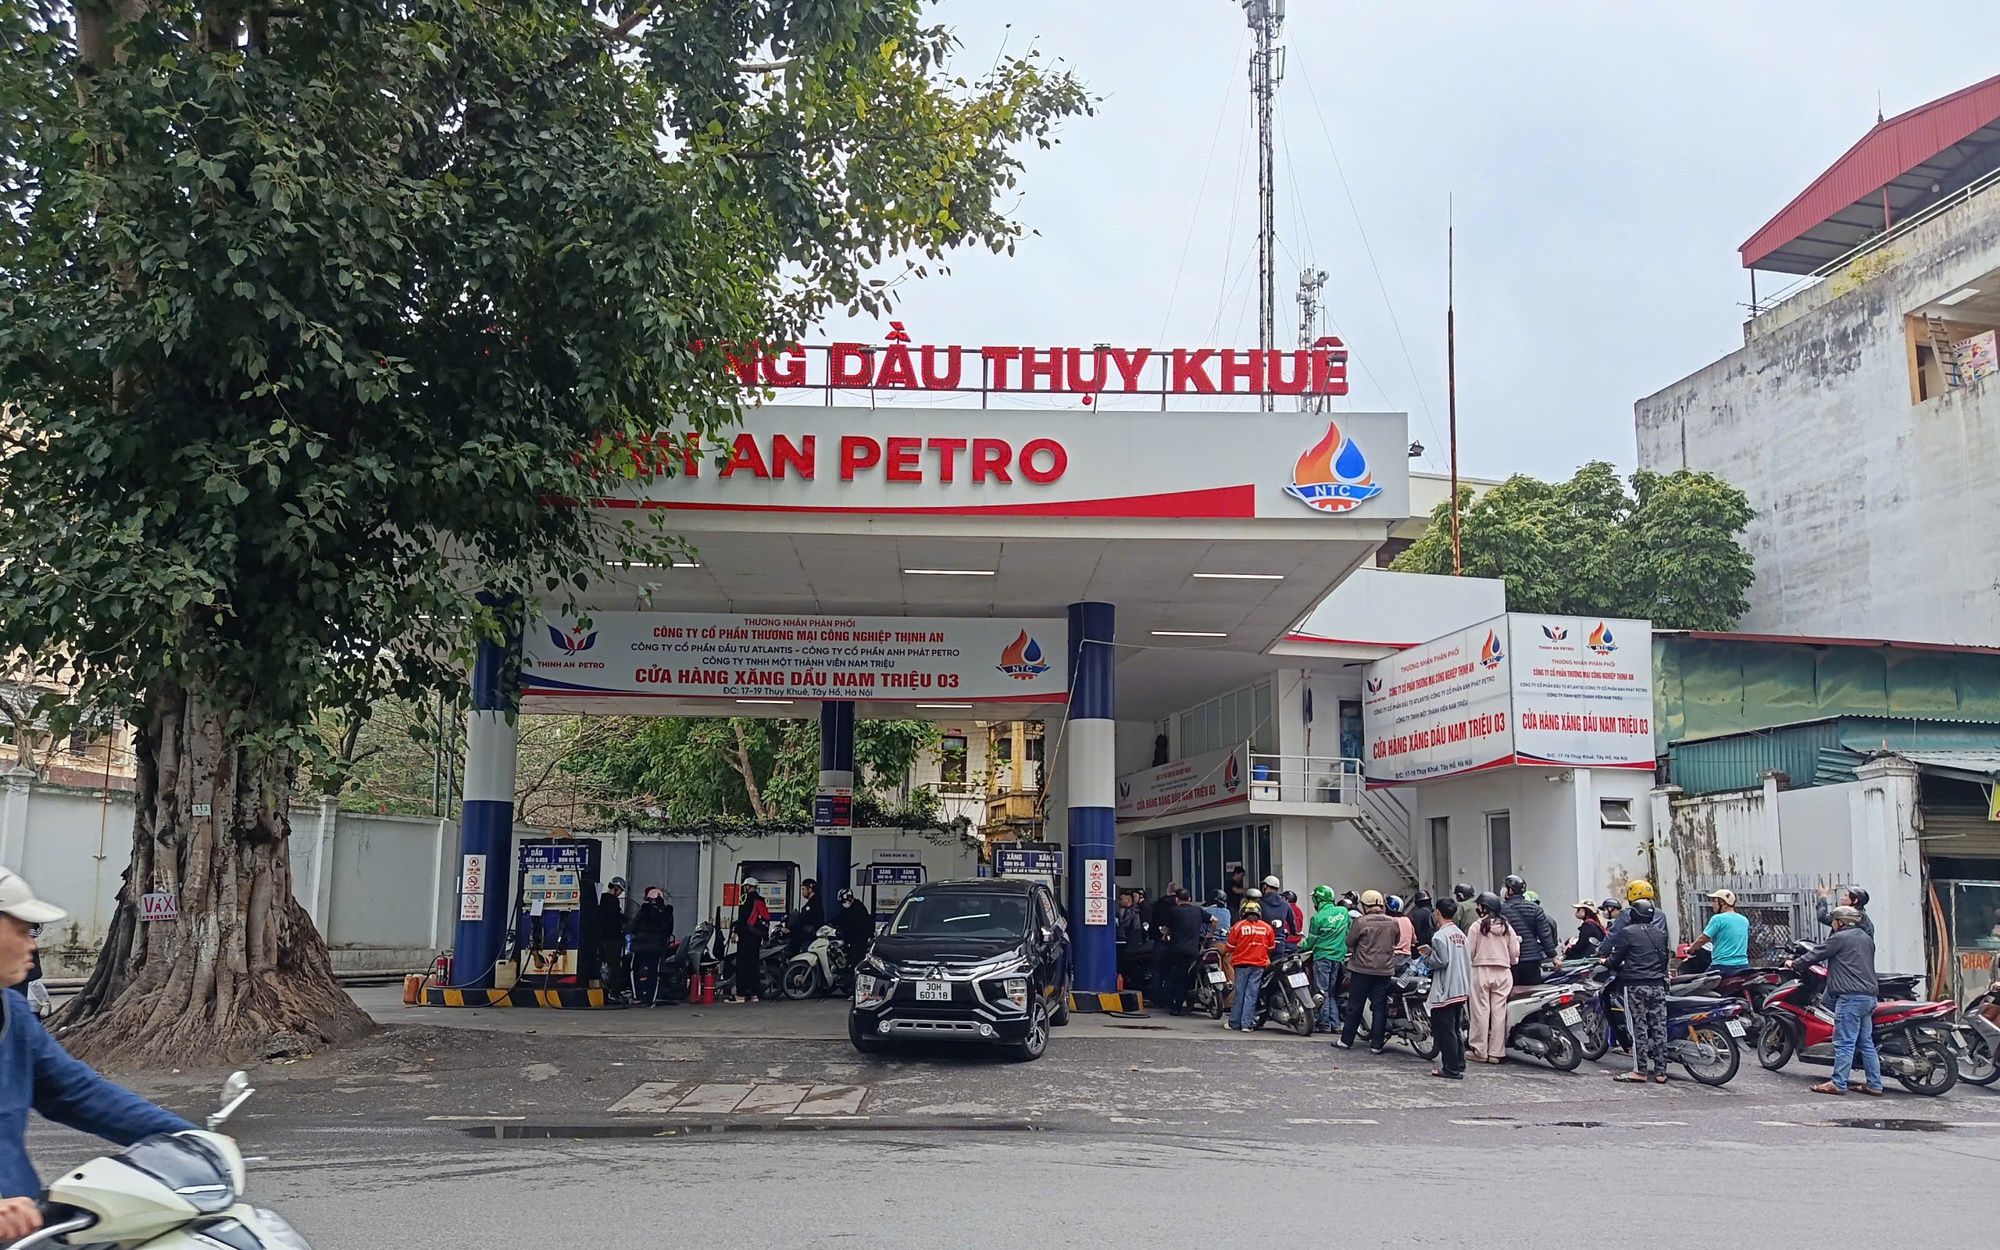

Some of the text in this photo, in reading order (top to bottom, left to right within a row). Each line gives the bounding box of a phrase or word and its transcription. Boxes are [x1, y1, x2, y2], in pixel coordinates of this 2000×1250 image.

[831, 321, 962, 390] DẦU
[981, 345, 1153, 406] THỤY
[1173, 336, 1349, 396] KHUÊ
[718, 433, 816, 480] AN
[840, 435, 1069, 484] PETRO
[1314, 485, 1351, 497] NTC
[744, 617, 856, 628] THƯƠNG NHÂN PHÂN PHỐI
[653, 625, 683, 638] CÔNG
[686, 628, 699, 638] TY
[752, 629, 793, 641] THƯƠNG
[797, 631, 817, 643] MẠI
[820, 629, 849, 641] CÔNG
[853, 630, 891, 644] NGHIỆP
[895, 632, 926, 644] THỊNH
[929, 633, 944, 643] AN
[631, 641, 659, 652] CÔNG
[661, 643, 673, 652] TY
[751, 646, 793, 654] ATLANTIS
[801, 646, 830, 655] CÔNG
[887, 648, 906, 657] ANH
[907, 647, 931, 657] PHÁT
[931, 649, 960, 657] PETRO
[702, 655, 730, 665] CÔNG
[746, 658, 770, 666] TNHH
[772, 657, 793, 668] MỘT
[793, 658, 824, 667] THÀNH
[825, 658, 846, 667] VIÊN
[848, 660, 868, 668] NAM
[870, 659, 895, 670] TRIỆU
[635, 664, 959, 690] CỬA HÀNG XĂNG DẦU NAM TRIỆU 03
[723, 686, 739, 695] ĐC:
[741, 686, 762, 695] 17-19
[764, 687, 784, 697] Thụy
[786, 688, 810, 696] Khuê,
[812, 688, 827, 698] Tây
[845, 688, 857, 697] Hà
[859, 688, 873, 698] Nội
[1522, 708, 1538, 729] CỬA
[1539, 710, 1559, 730] HÀNG
[1561, 712, 1581, 731] XĂNG
[1599, 716, 1616, 733] NAM
[1618, 715, 1637, 737] TRIỆU
[1640, 718, 1649, 734] 03
[1373, 737, 1387, 760] CỬA
[1388, 735, 1407, 756] HÀNG
[1408, 730, 1429, 752] XĂNG
[1448, 721, 1467, 743] NAM
[1468, 713, 1492, 740] TRIỆU
[1495, 712, 1506, 732] 03
[1006, 852, 1023, 860] XĂNG
[1328, 913, 1345, 923] Grab
[926, 983, 942, 991] 30H
[920, 991, 948, 1000] 603.18
